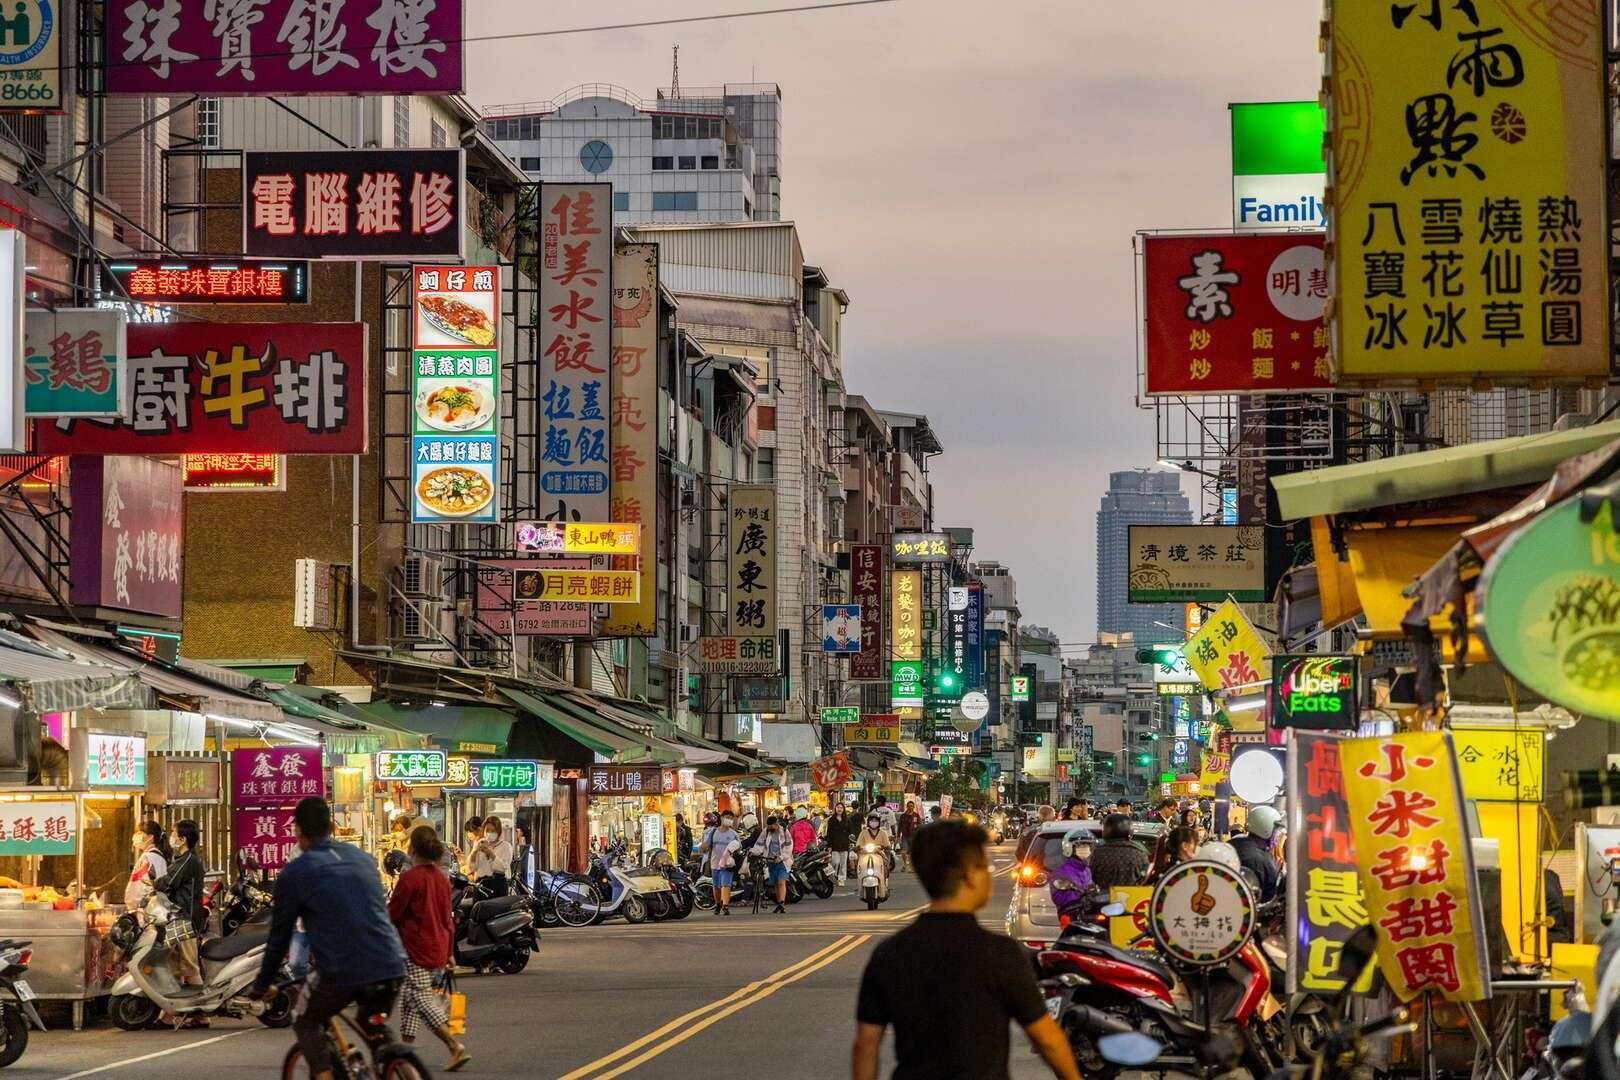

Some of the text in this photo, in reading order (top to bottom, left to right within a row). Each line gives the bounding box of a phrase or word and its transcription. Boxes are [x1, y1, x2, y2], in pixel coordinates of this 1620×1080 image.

[122, 0, 447, 81] 珠寶銀樓
[252, 172, 456, 236] 電腦維修
[1240, 196, 1328, 227] Family
[130, 268, 283, 297] 鑫發珠寶銀樓
[418, 270, 494, 291] 蚵仔煎
[543, 190, 607, 374] 佳美水餃
[1180, 251, 1239, 321] 素
[1272, 269, 1328, 299] 明慧
[1362, 202, 1407, 351] 八寶冰
[1420, 199, 1466, 349] 雪花冰
[1479, 197, 1524, 347] 燒仙草
[1538, 195, 1582, 346] 熱湯圓
[418, 356, 494, 376] 清蒸肉圓
[55, 340, 346, 432] 廚牛排
[541, 379, 576, 467] 拉麵
[575, 380, 609, 466] 蓋飯
[417, 441, 494, 463] 大腸蚵仔麵線
[895, 540, 948, 556] 咖哩飯
[544, 574, 633, 597] 月亮蝦餅
[735, 523, 768, 629] 廣東粥
[953, 614, 965, 622] 3C
[702, 638, 774, 660] 地理 命相
[1290, 672, 1341, 694] Uber
[1290, 692, 1341, 712] Eats
[251, 752, 306, 777] 鑫發
[241, 780, 318, 794] 珠寶銀樓
[1359, 744, 1461, 993] 小米甜甜圈
